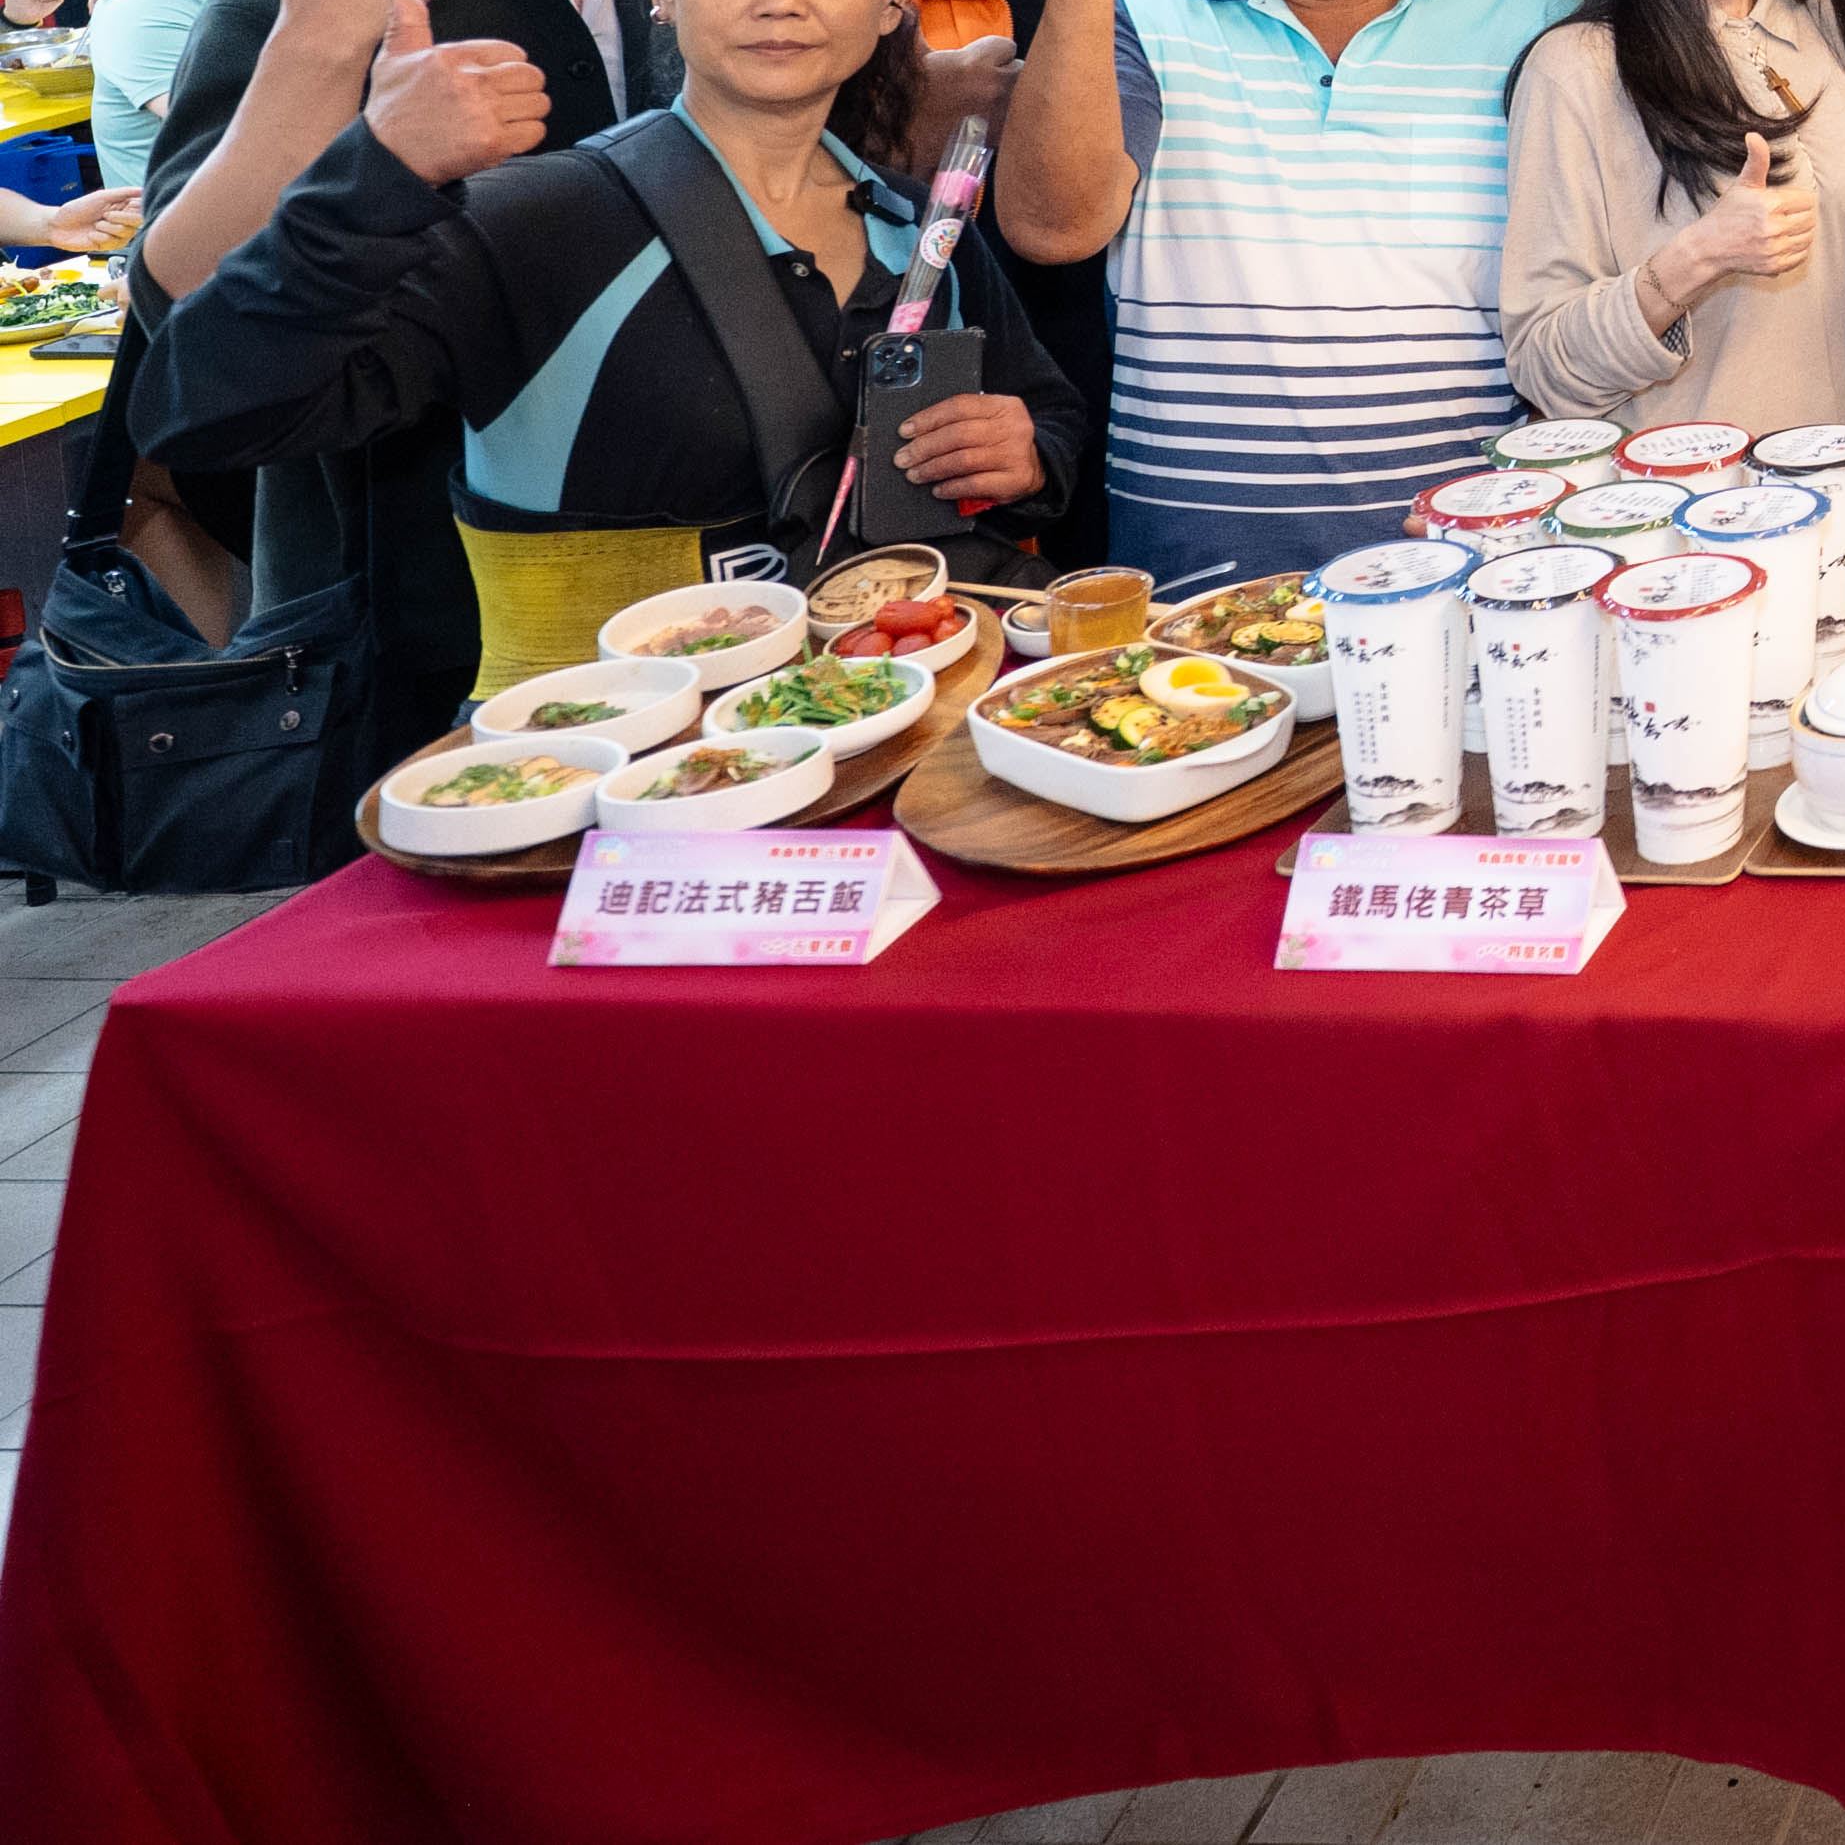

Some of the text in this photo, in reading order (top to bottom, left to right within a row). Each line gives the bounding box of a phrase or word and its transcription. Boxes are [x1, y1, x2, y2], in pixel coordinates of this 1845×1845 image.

[599, 879, 867, 915] 迪記法式豬舌飯
[1328, 884, 1549, 920] 鐵馬佬青茶草
